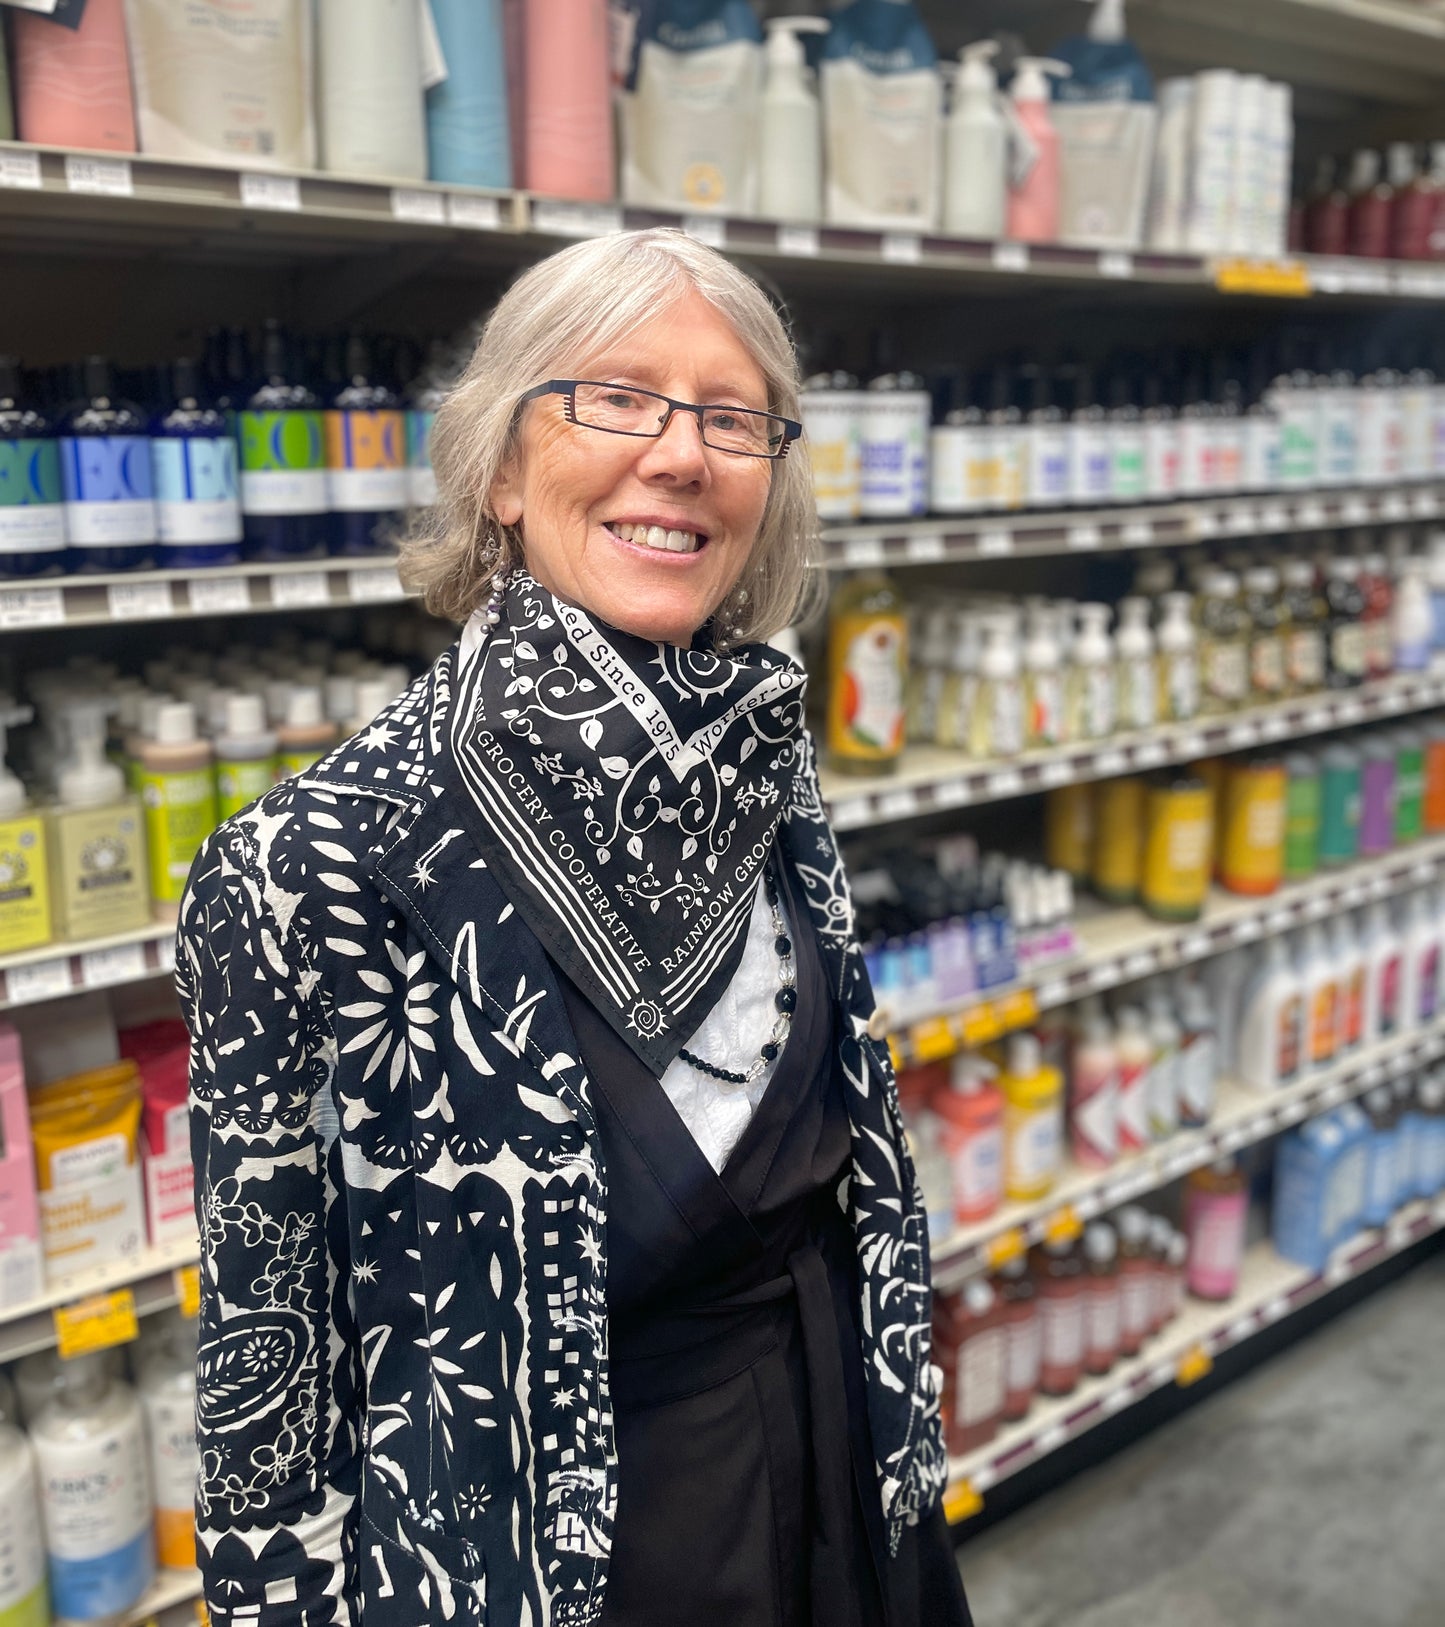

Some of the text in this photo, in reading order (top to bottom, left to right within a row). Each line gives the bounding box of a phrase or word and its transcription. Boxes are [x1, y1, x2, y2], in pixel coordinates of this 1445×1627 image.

[589, 644, 646, 707] Since
[646, 709, 680, 761] 1975
[690, 672, 802, 758] Worker-O
[477, 730, 553, 825] GROCERY
[549, 829, 652, 973] COOPERATIVE
[659, 881, 735, 975] RAINBOW
